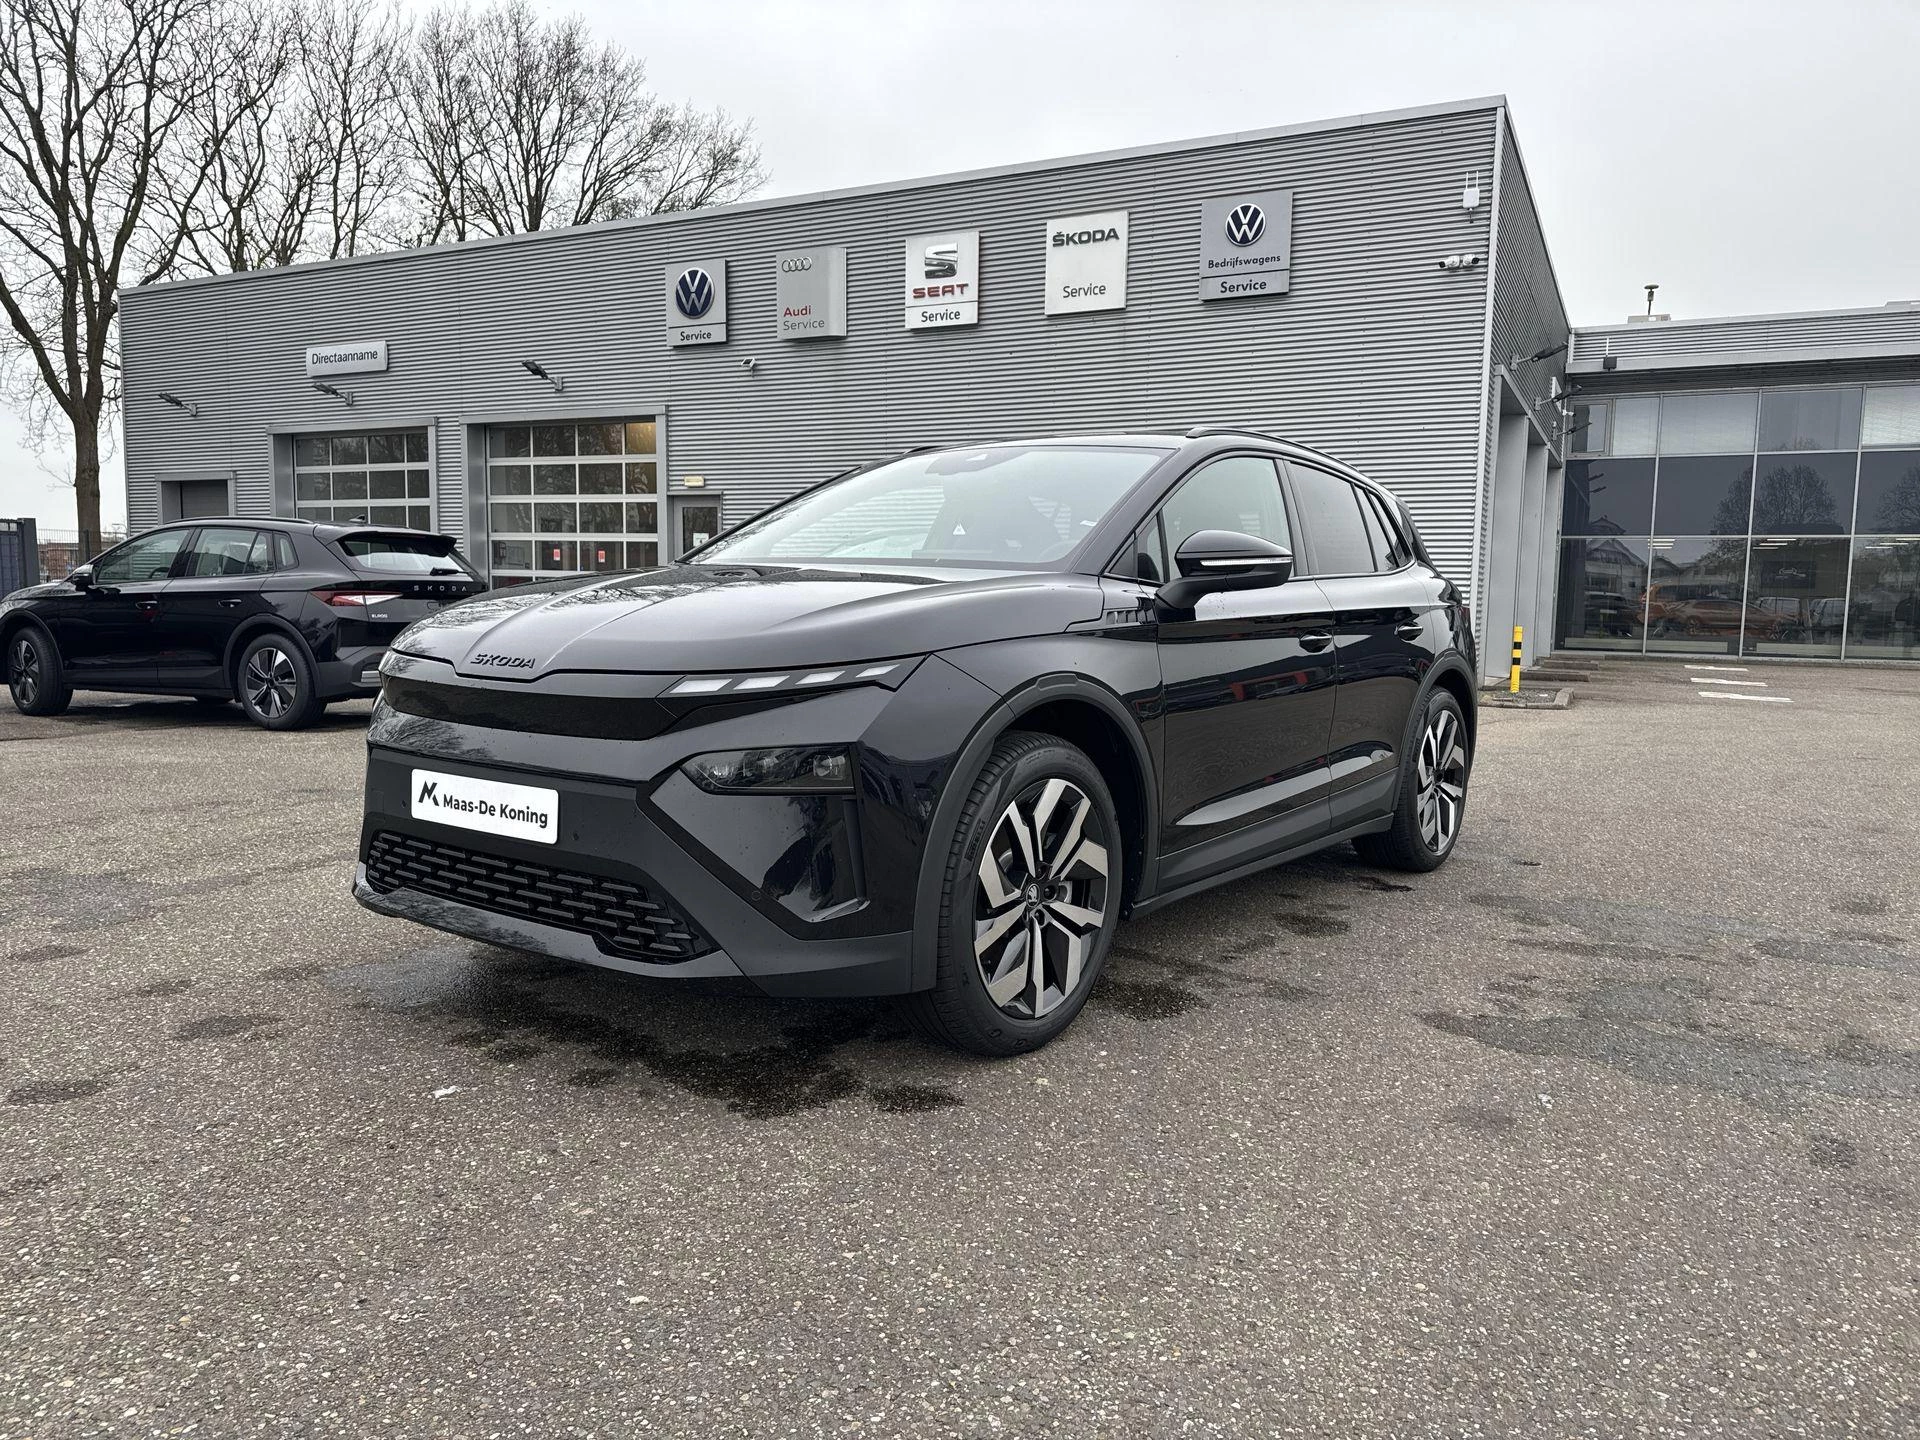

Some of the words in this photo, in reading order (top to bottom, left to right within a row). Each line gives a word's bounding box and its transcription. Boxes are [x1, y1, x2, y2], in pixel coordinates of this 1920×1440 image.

[1052, 228, 1120, 247] ŠKODA
[1207, 254, 1281, 270] Bedrijfswagens
[912, 283, 969, 299] SEAT
[1062, 283, 1107, 299] Service
[1219, 280, 1267, 294] Service
[783, 305, 812, 318] Audi
[920, 308, 961, 324] Service
[783, 318, 825, 331] Service
[680, 329, 712, 342] Service
[311, 350, 379, 365] Directaanname
[443, 793, 496, 817] Maas-De
[499, 803, 549, 829] Koning
